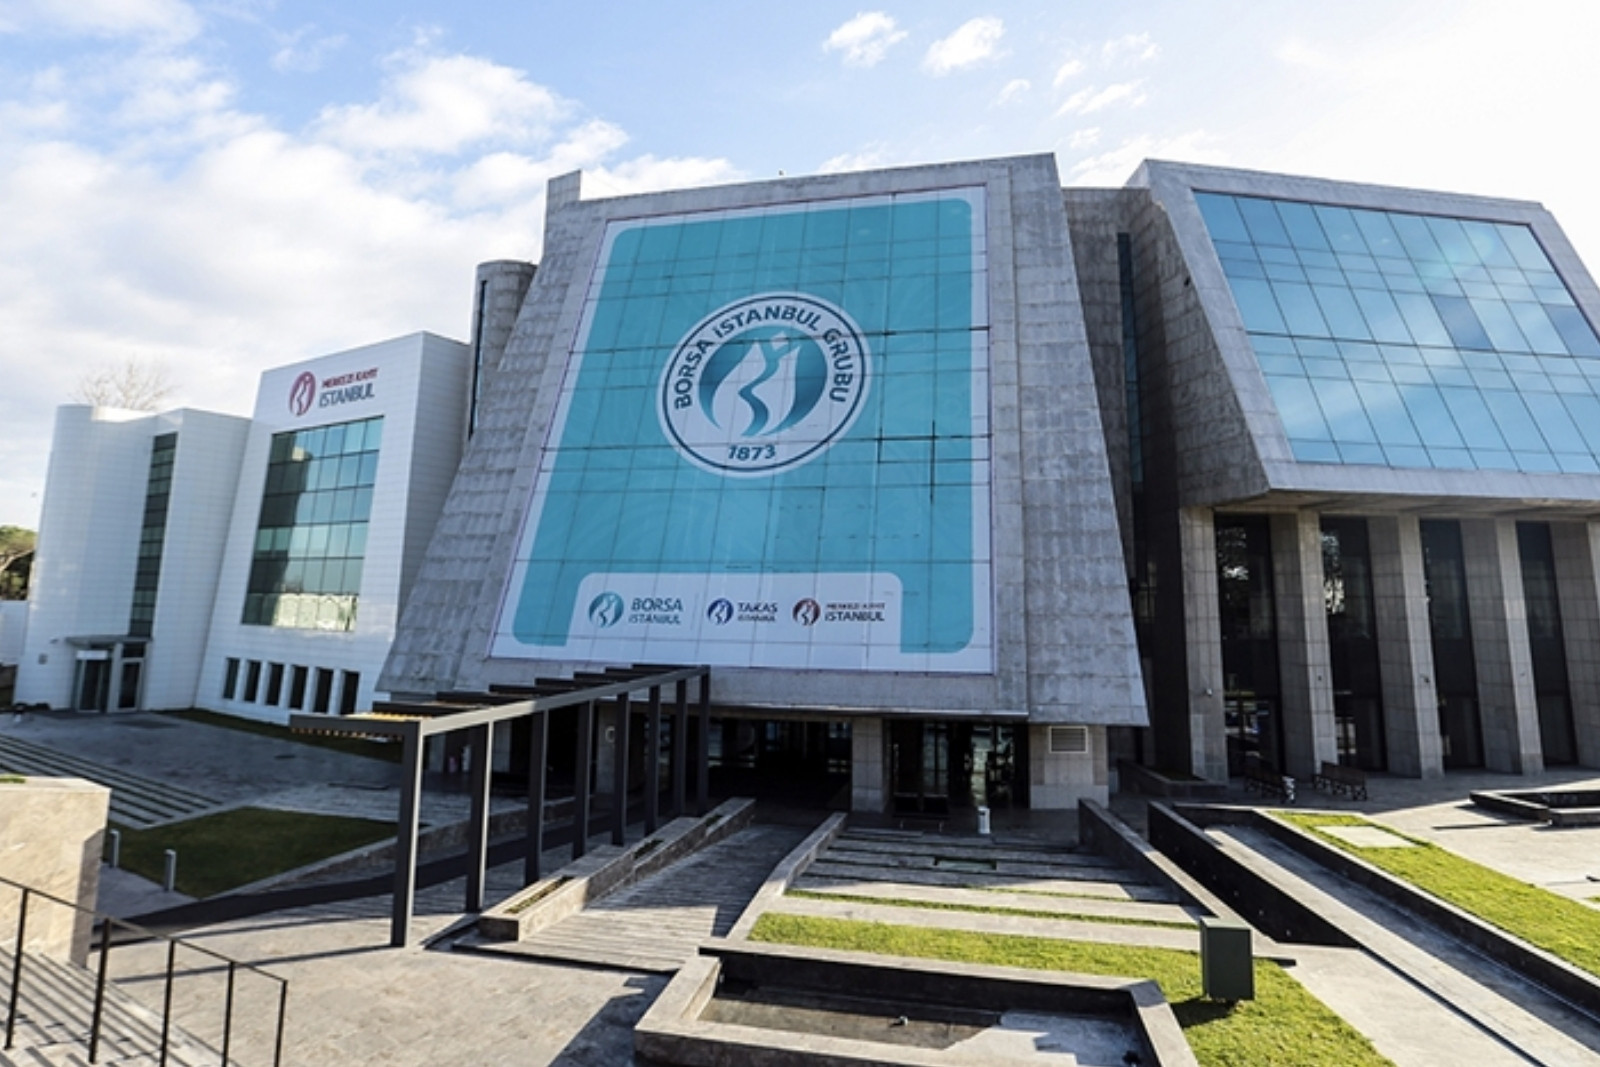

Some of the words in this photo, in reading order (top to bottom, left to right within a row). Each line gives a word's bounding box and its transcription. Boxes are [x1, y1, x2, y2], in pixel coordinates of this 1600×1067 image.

[673, 339, 715, 410] BORSA
[822, 327, 854, 404] GRUBU
[728, 444, 776, 461] 1873
[631, 597, 683, 612] BORSA
[738, 601, 778, 612] TAKAS
